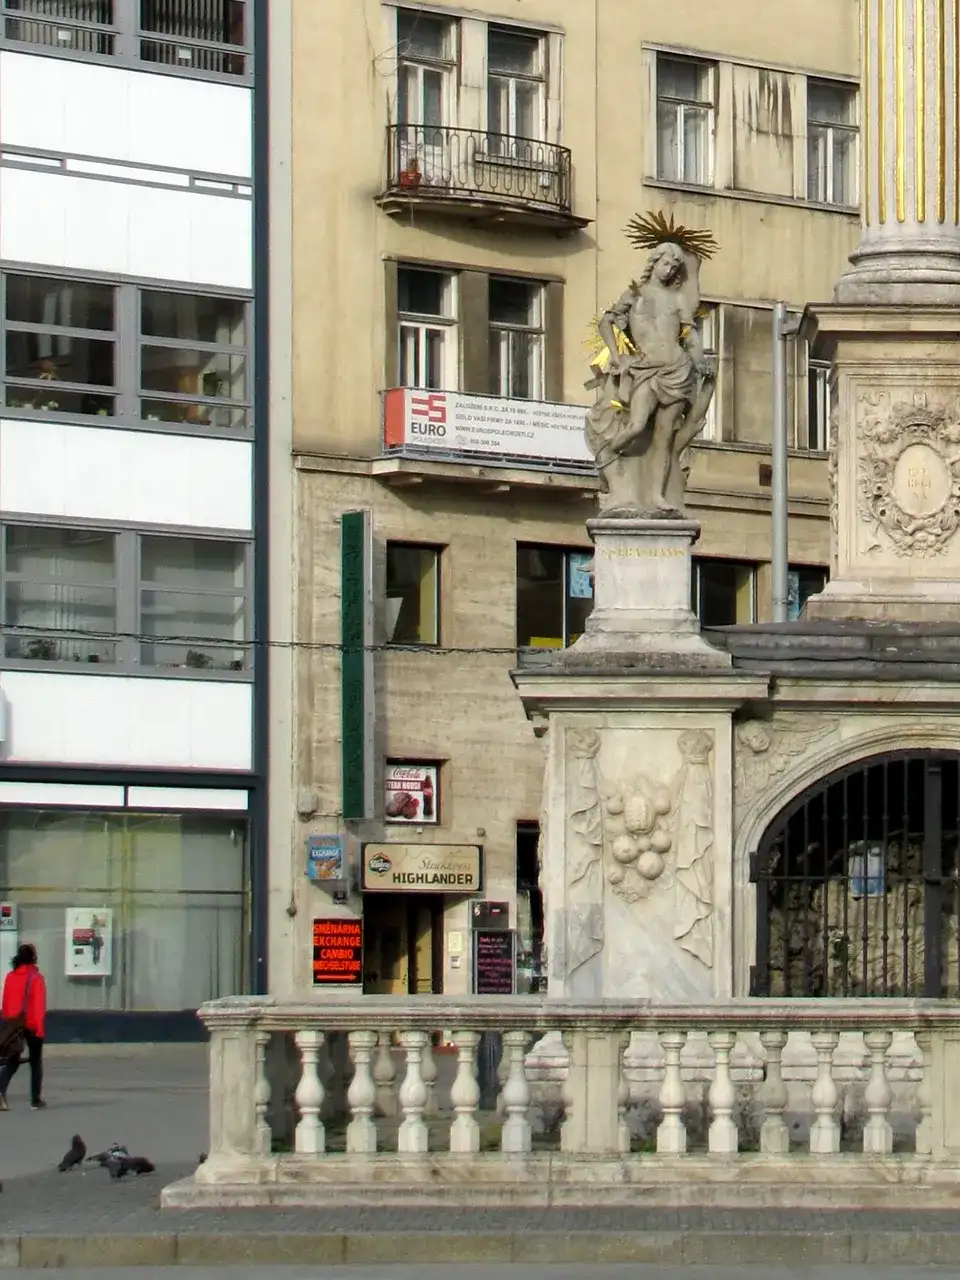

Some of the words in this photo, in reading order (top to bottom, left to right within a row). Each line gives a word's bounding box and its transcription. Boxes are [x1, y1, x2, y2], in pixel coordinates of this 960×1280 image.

[411, 422, 446, 436] EURO
[392, 872, 473, 884] HIGHLANDER
[313, 936, 361, 947] EXCHANGE
[320, 948, 354, 959] CAMBIO
